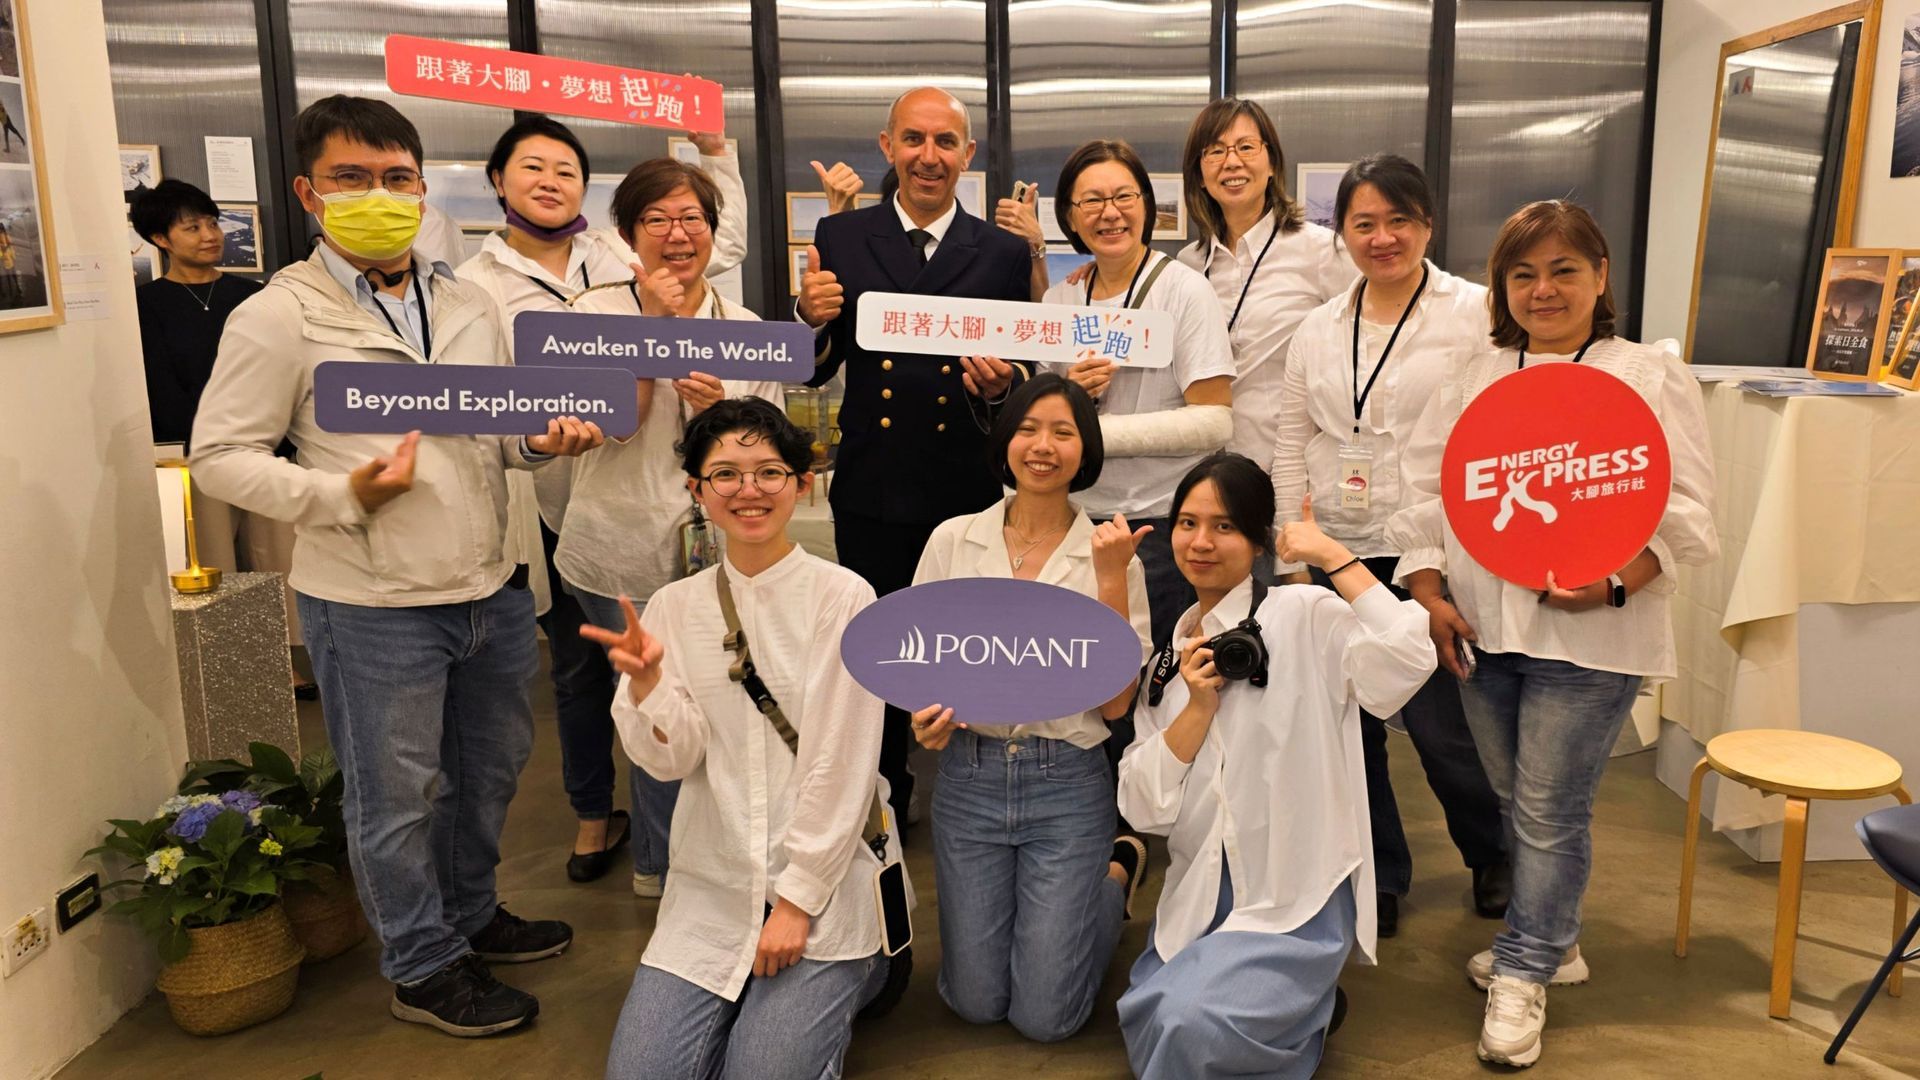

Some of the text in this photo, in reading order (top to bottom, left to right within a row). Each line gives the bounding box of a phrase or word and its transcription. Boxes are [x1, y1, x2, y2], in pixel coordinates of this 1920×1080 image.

[541, 335, 793, 363] Awaken To The World.
[346, 388, 615, 417] Beyond Exploration.
[1571, 476, 1646, 502] 大腳旅行社
[935, 634, 1099, 668] PONANT
